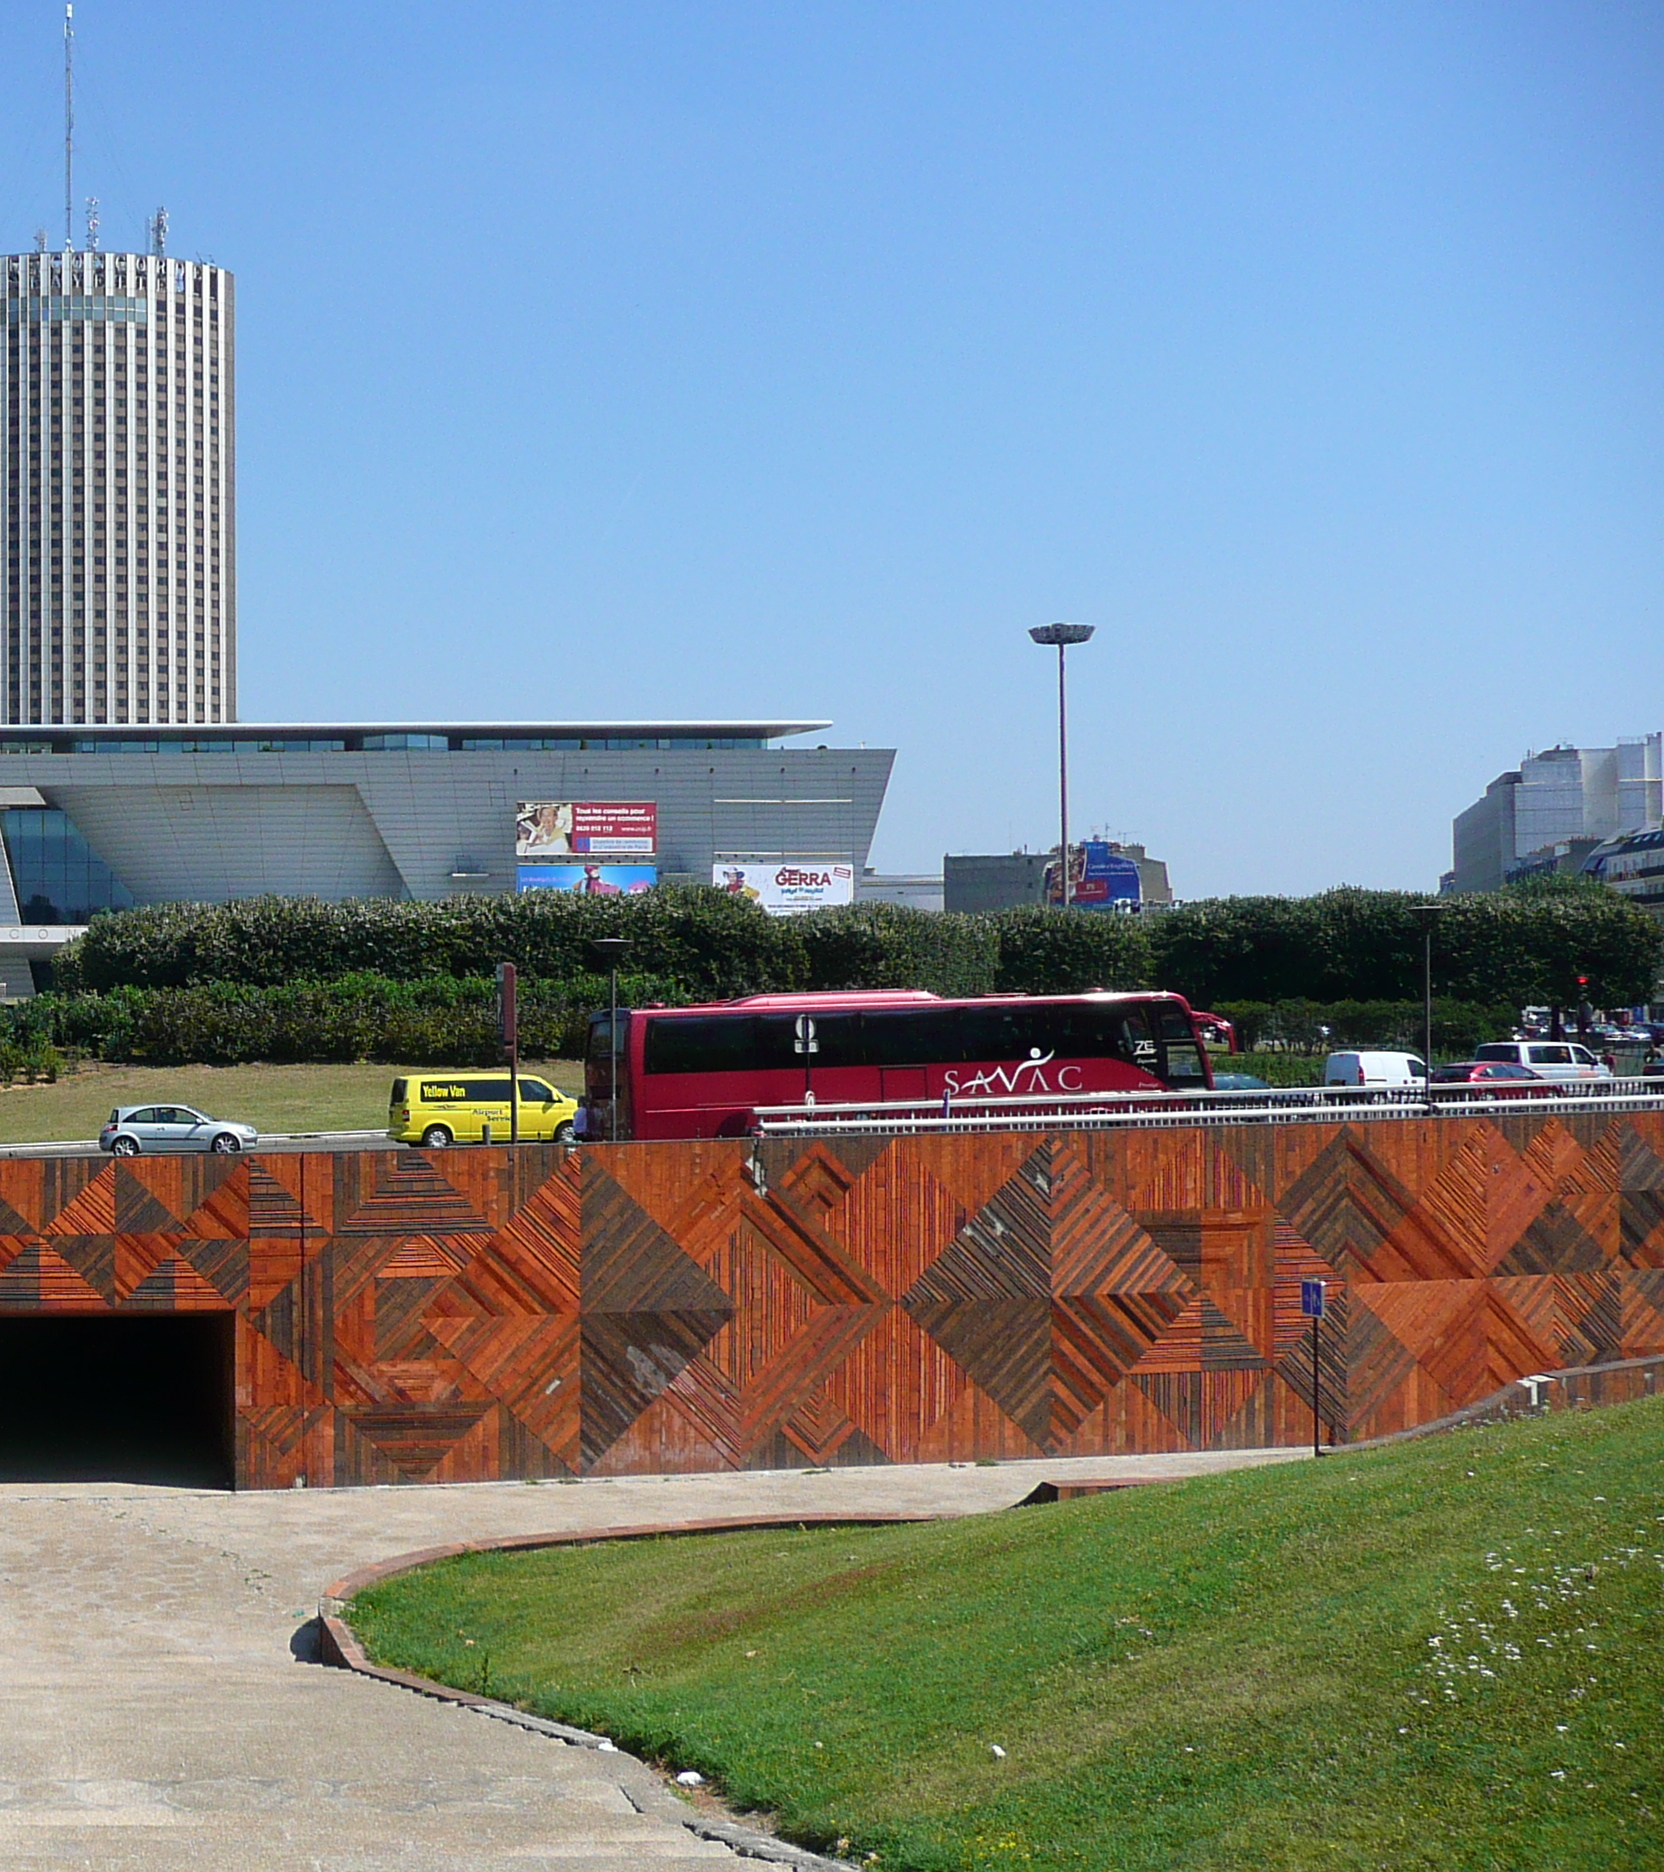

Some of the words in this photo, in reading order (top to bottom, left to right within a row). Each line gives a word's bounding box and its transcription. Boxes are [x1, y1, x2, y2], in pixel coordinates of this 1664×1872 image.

[50, 255, 203, 280] CONCORDE
[775, 871, 832, 886] GERRA
[944, 1060, 1083, 1096] SAVAC
[422, 1085, 448, 1098] Yellow
[449, 1085, 466, 1098] Van
